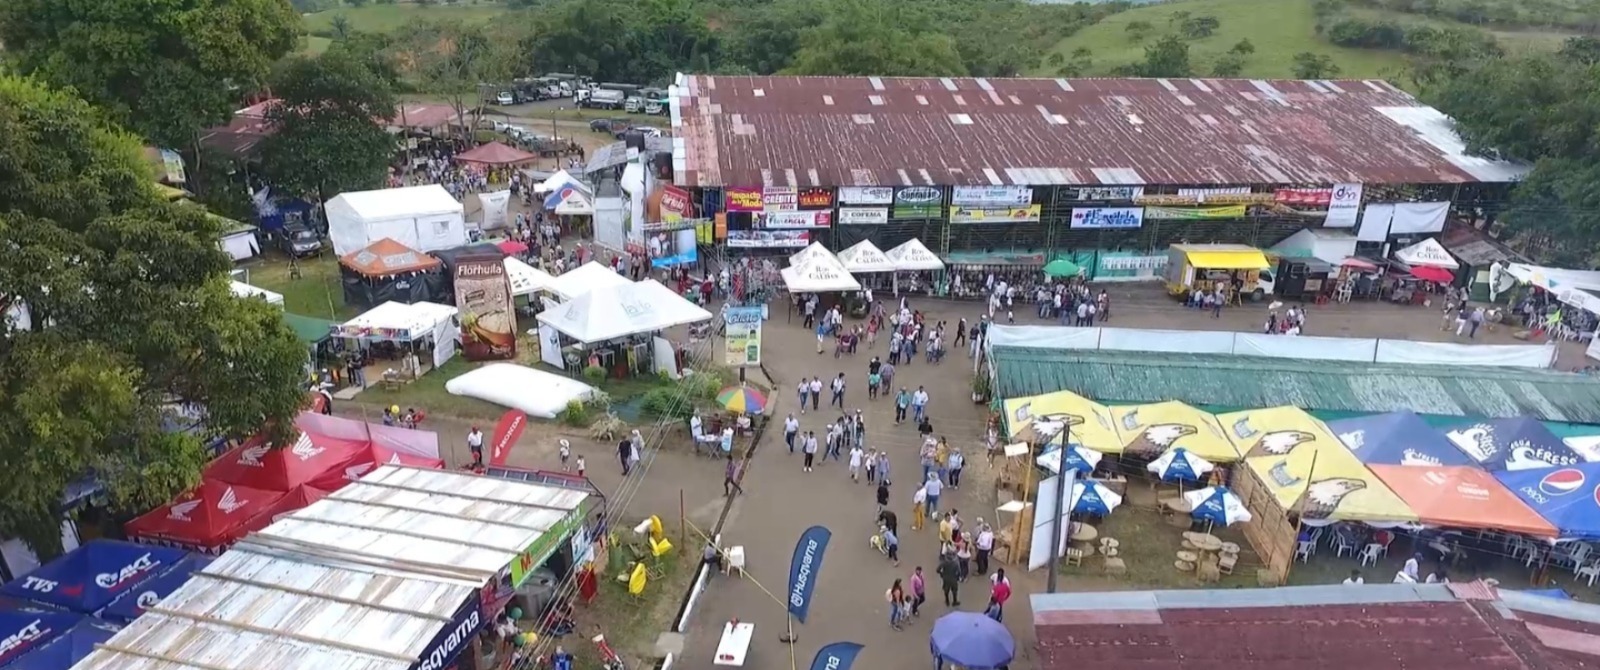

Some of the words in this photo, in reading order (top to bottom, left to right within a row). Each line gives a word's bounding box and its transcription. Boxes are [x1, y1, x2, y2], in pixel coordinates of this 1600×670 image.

[458, 264, 502, 276] Florhuila
[500, 416, 522, 449] HONDA
[236, 458, 264, 468] HONDA
[118, 552, 152, 584] AKT
[792, 538, 818, 595] Husqvarna
[22, 575, 59, 593] TVS
[416, 610, 480, 670] sqvarna
